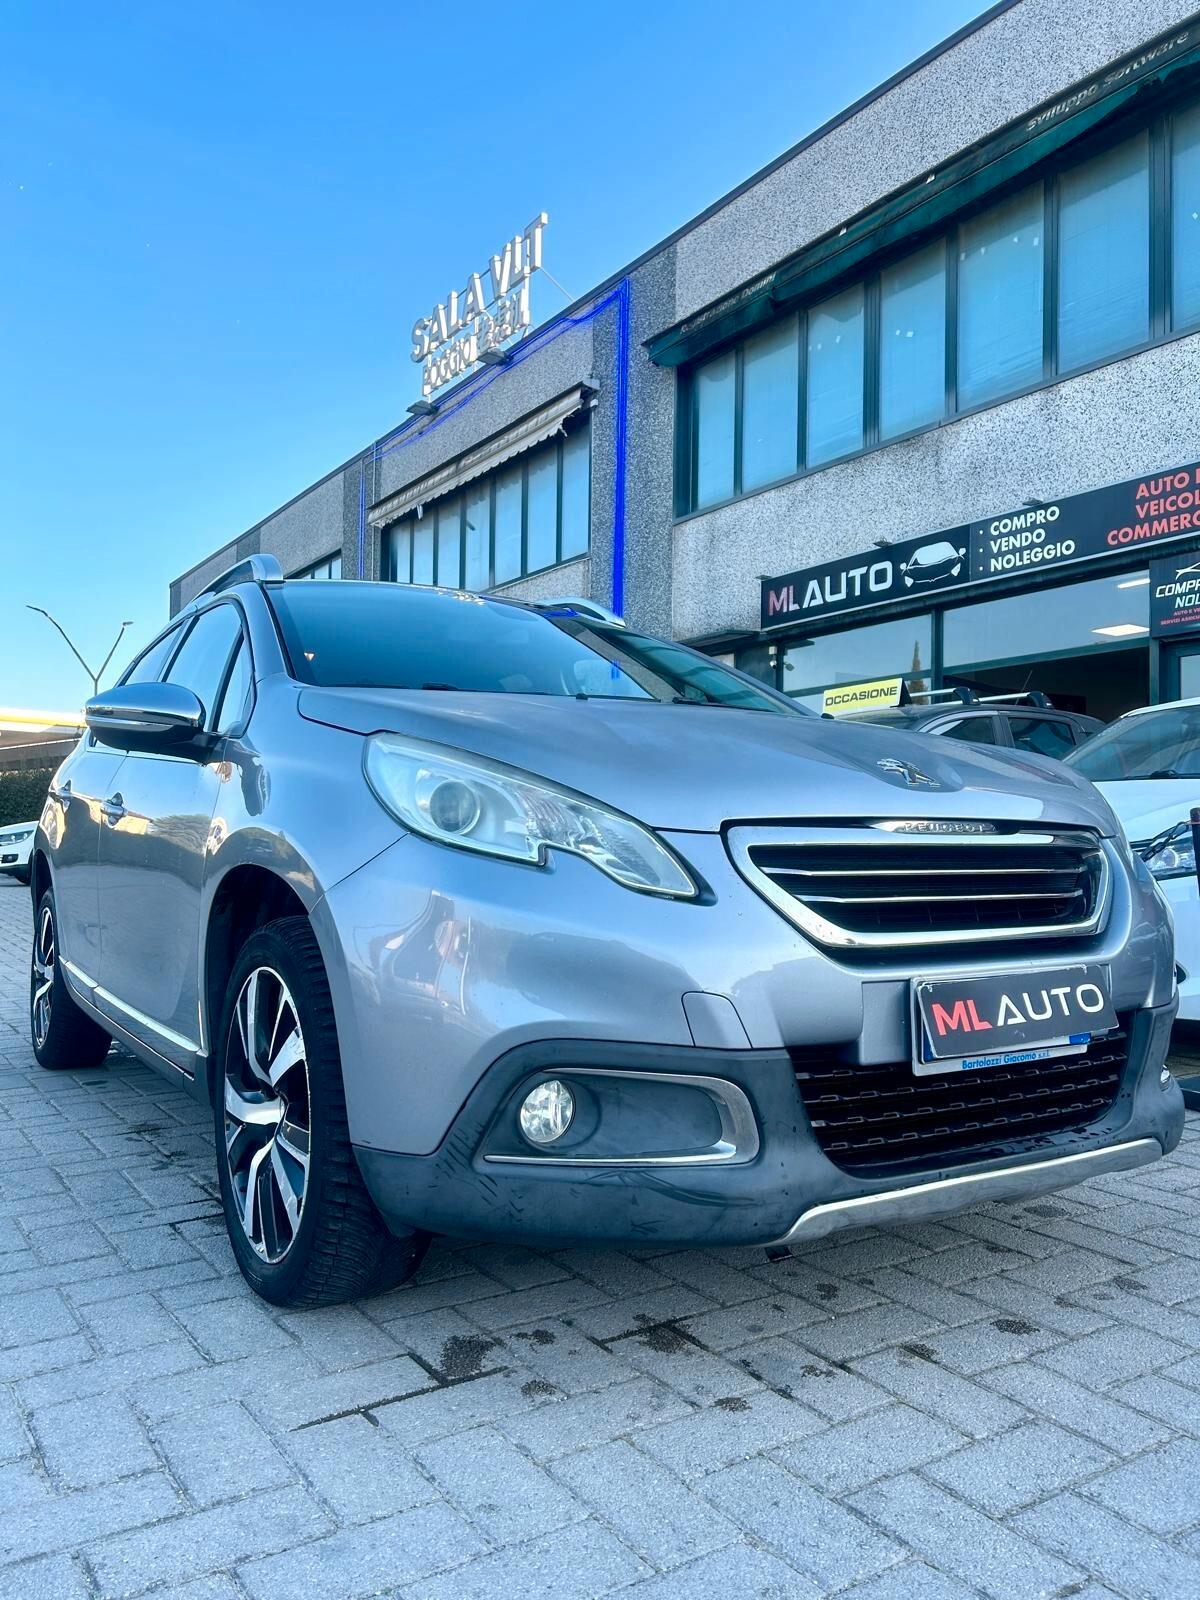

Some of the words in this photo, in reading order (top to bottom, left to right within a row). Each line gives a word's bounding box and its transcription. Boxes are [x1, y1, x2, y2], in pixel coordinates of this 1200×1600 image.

[1136, 472, 1190, 500] AUTO
[990, 506, 1060, 535] COMPRO
[1107, 510, 1200, 545] COMMERC
[990, 528, 1046, 553] VENDO
[990, 540, 1075, 572] NOLEGGIO
[768, 585, 800, 616] ML
[803, 560, 893, 608] AUTO
[825, 686, 898, 706] OCCASIONE
[931, 1000, 993, 1036] ML
[997, 983, 1104, 1027] AUTO
[962, 1055, 1002, 1070] Bartolozzi
[1004, 1052, 1037, 1064] Giacomo
